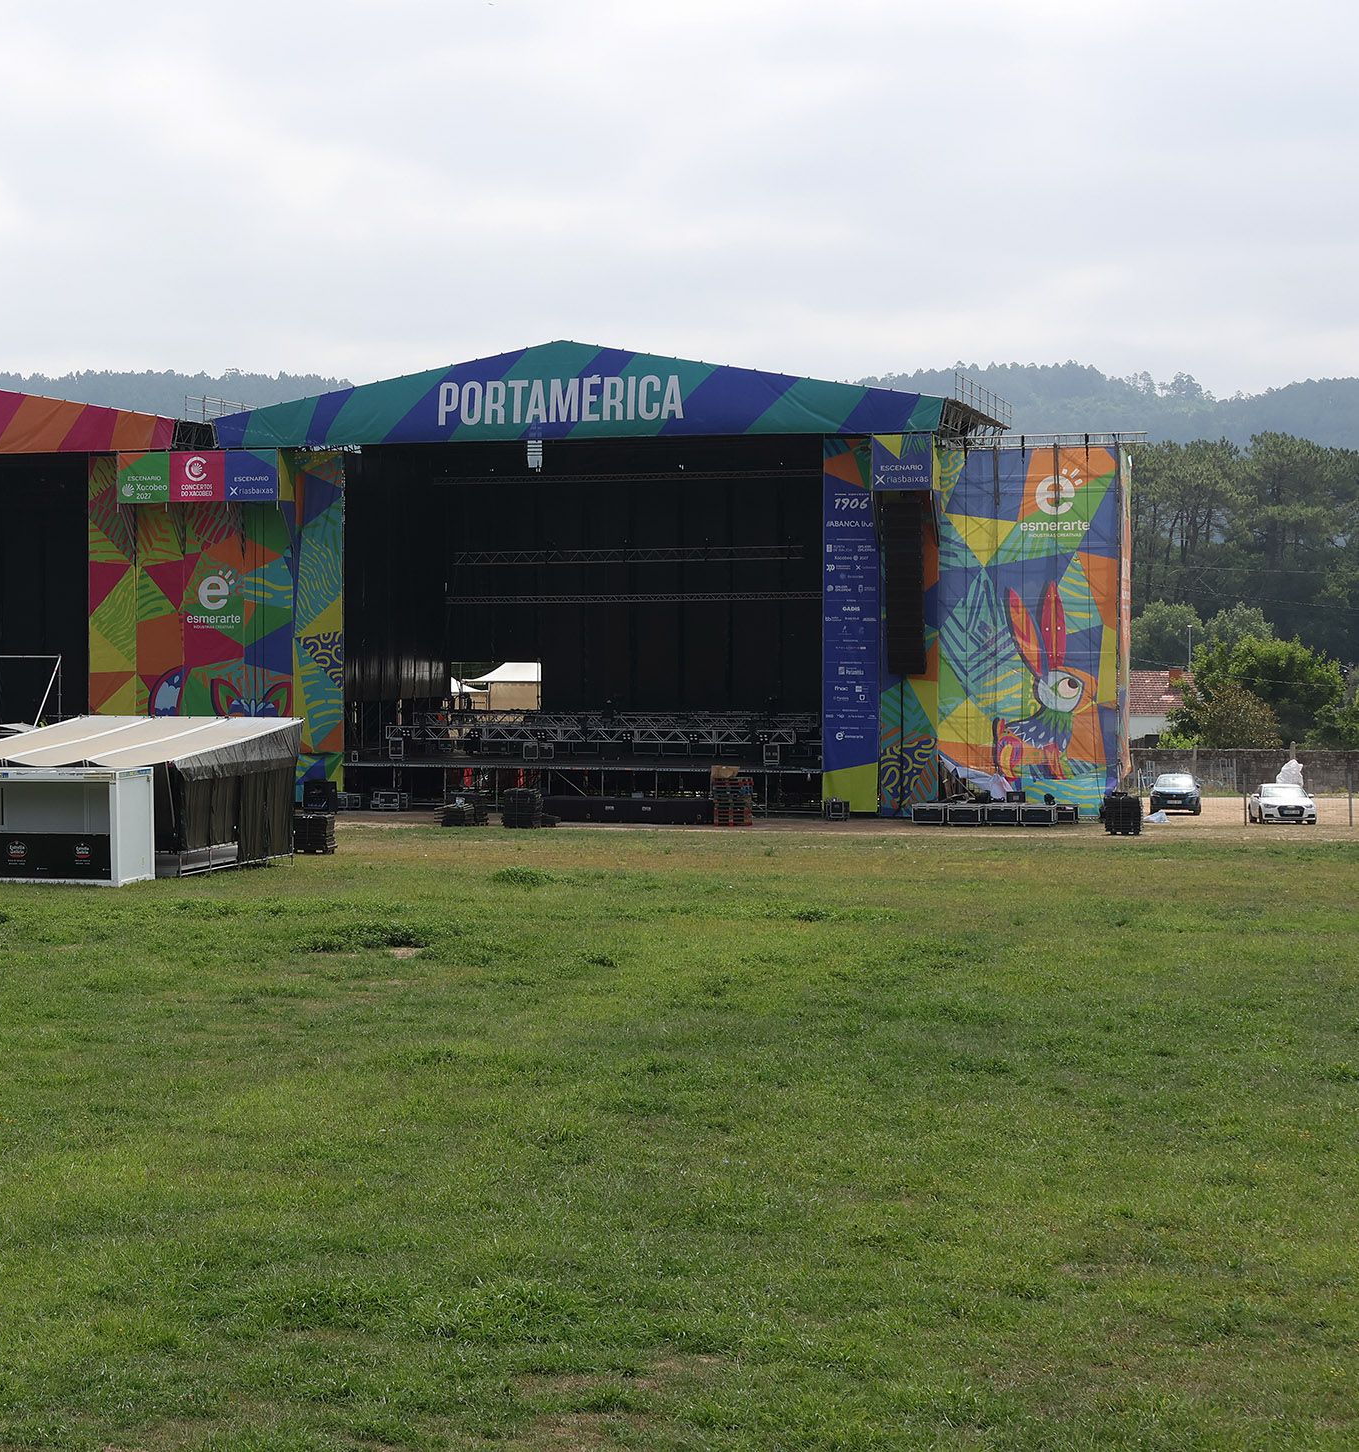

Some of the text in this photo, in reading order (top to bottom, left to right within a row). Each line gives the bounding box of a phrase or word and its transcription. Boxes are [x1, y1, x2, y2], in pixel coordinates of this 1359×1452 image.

[437, 374, 684, 426] PORTAMÉRICA
[136, 483, 168, 491] Xacobeo
[834, 497, 870, 510] 1906
[1020, 520, 1091, 531] esmerarte
[186, 613, 241, 624] esmerarte
